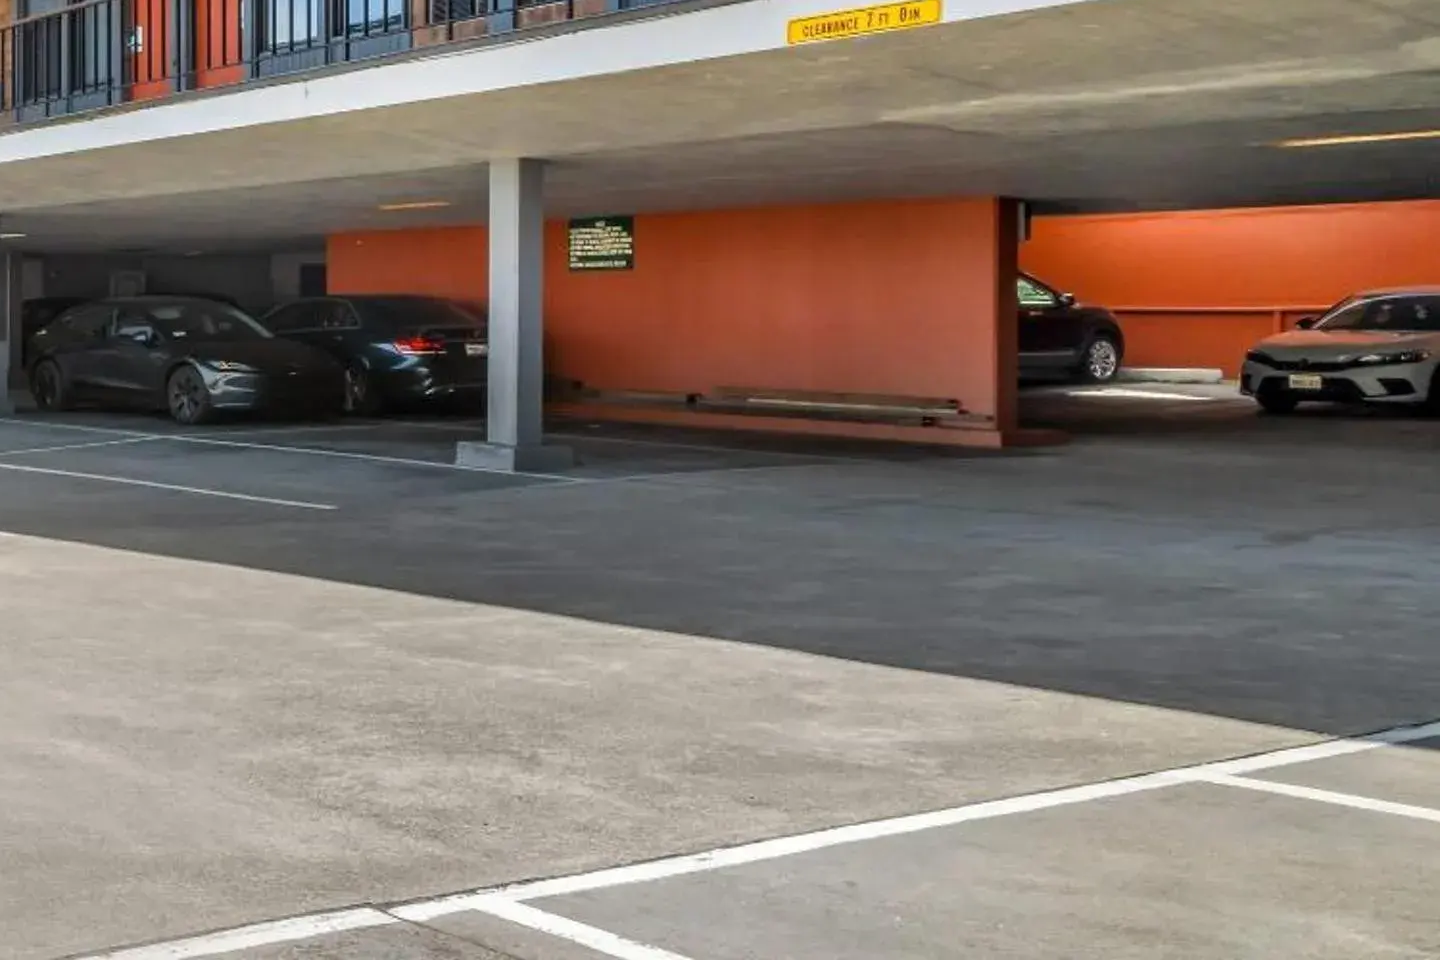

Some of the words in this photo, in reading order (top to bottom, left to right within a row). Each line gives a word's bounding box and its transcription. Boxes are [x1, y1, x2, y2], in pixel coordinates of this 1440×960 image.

[802, 18, 859, 38] CLEARANCE
[867, 12, 874, 28] 7
[878, 13, 890, 25] FT
[909, 7, 921, 19] IN
